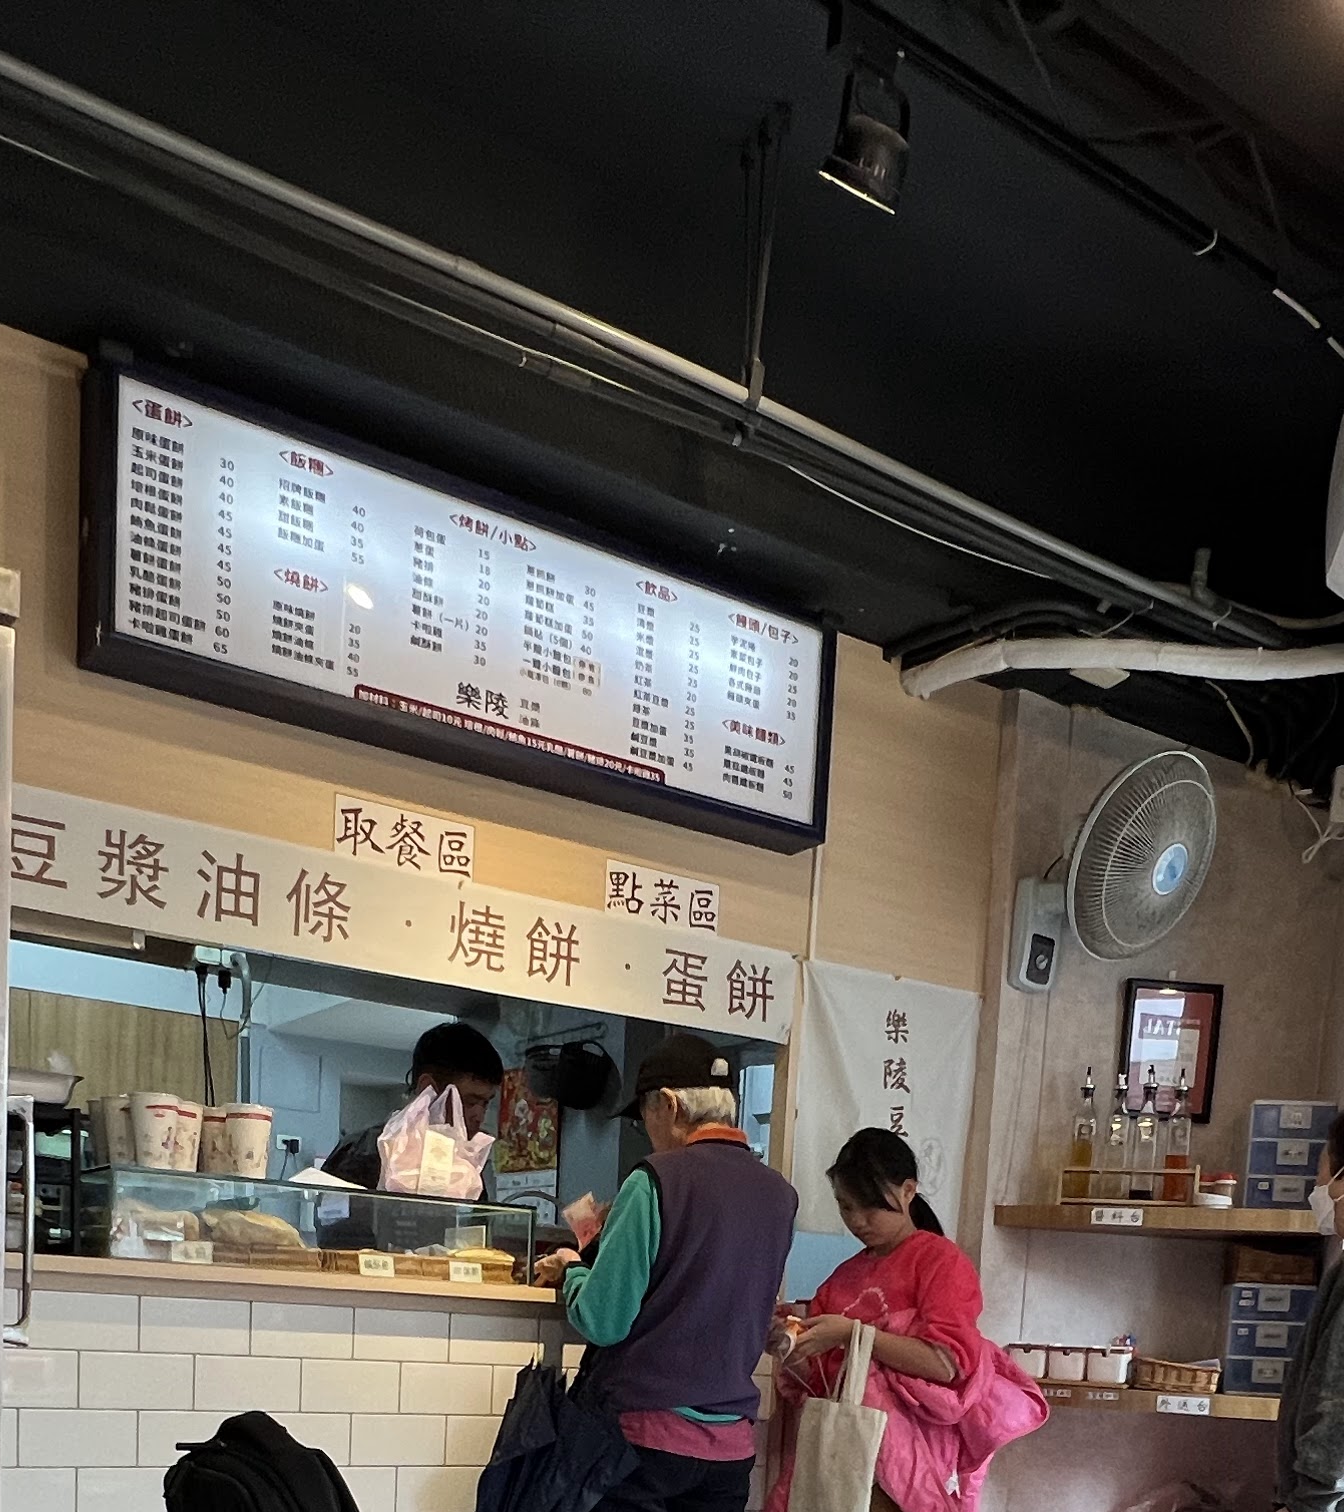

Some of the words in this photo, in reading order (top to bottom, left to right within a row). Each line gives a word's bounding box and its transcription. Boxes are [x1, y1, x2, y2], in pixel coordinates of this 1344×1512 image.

[131, 444, 183, 472] 玉米蛋餅
[219, 475, 234, 488] 40
[219, 457, 235, 472] 30
[218, 492, 234, 505] 40
[218, 509, 233, 522] 45
[351, 505, 366, 518] 40
[217, 526, 233, 539] 45
[350, 521, 365, 533] 40
[350, 536, 364, 549] 35
[413, 524, 447, 546] 荷包蛋
[478, 548, 491, 561] 15
[217, 543, 232, 556] 45
[351, 552, 364, 564] 55
[216, 560, 232, 573] 45
[478, 564, 491, 576] 18
[216, 575, 232, 589] 50
[477, 579, 491, 592] 20
[584, 585, 597, 598] 30
[216, 593, 231, 605] 50
[477, 594, 490, 607] 20
[583, 599, 595, 612] 45
[215, 609, 231, 622] 50
[475, 609, 489, 621] 20
[582, 615, 595, 627] 35
[215, 625, 230, 638] 60
[348, 623, 361, 635] 20
[475, 624, 488, 637] 20
[689, 621, 701, 634] 25
[581, 629, 594, 642] 50
[213, 641, 228, 655] 65
[347, 637, 360, 649] 35
[473, 639, 487, 652] 35
[689, 636, 700, 648] 25
[580, 644, 593, 656] 40
[688, 650, 700, 661] 25
[347, 652, 360, 664] 40
[473, 655, 487, 667] 30
[788, 656, 799, 668] 20
[346, 666, 359, 678] 55
[688, 664, 699, 675] 25
[788, 670, 799, 682] 20
[687, 677, 698, 689] 25
[787, 684, 798, 695] 25
[456, 681, 509, 720] 樂陵
[686, 691, 697, 703] 20
[786, 697, 797, 709] 20
[684, 705, 696, 717] 25
[684, 719, 696, 731] 25
[683, 733, 694, 745] 35
[683, 747, 695, 759] 35
[682, 760, 694, 772] 45
[784, 764, 796, 775] 45
[782, 777, 794, 789] 45
[782, 790, 794, 801] 50
[336, 807, 474, 880] 取餐區
[606, 869, 718, 934] 點菜區
[446, 901, 582, 989] 燒餅
[660, 948, 776, 1024] 蛋餅
